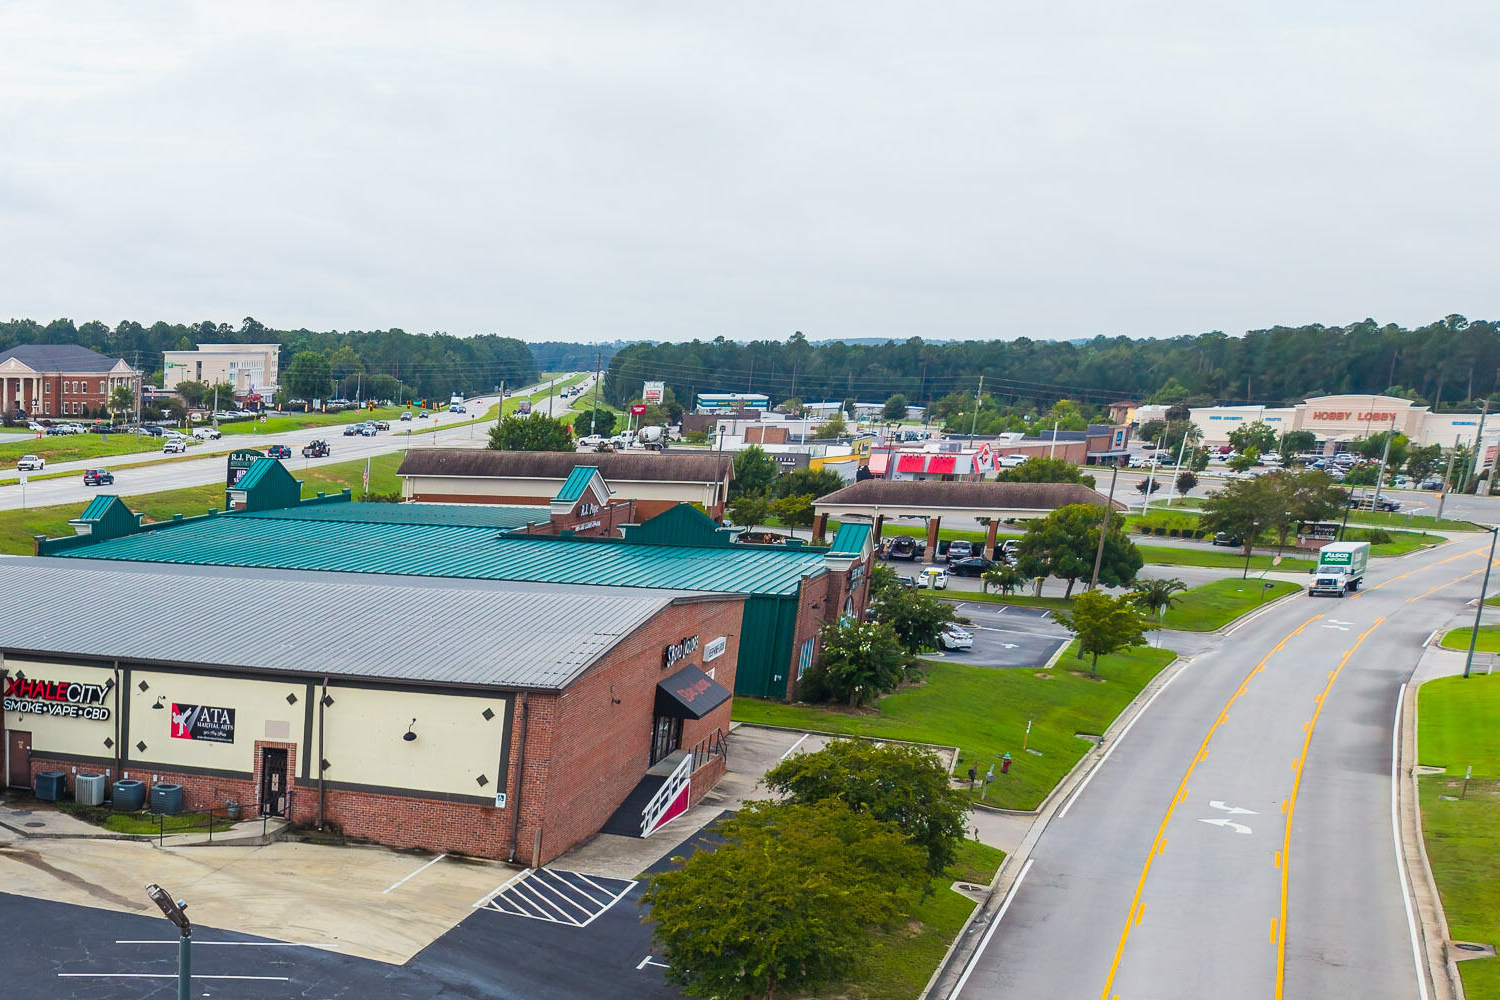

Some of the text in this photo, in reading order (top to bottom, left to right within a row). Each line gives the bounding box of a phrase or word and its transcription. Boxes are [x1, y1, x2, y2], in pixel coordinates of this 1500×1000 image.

[1313, 411, 1397, 421] HOBBY LOBBY
[83, 707, 109, 720] CBD
[200, 707, 231, 725] ATA
